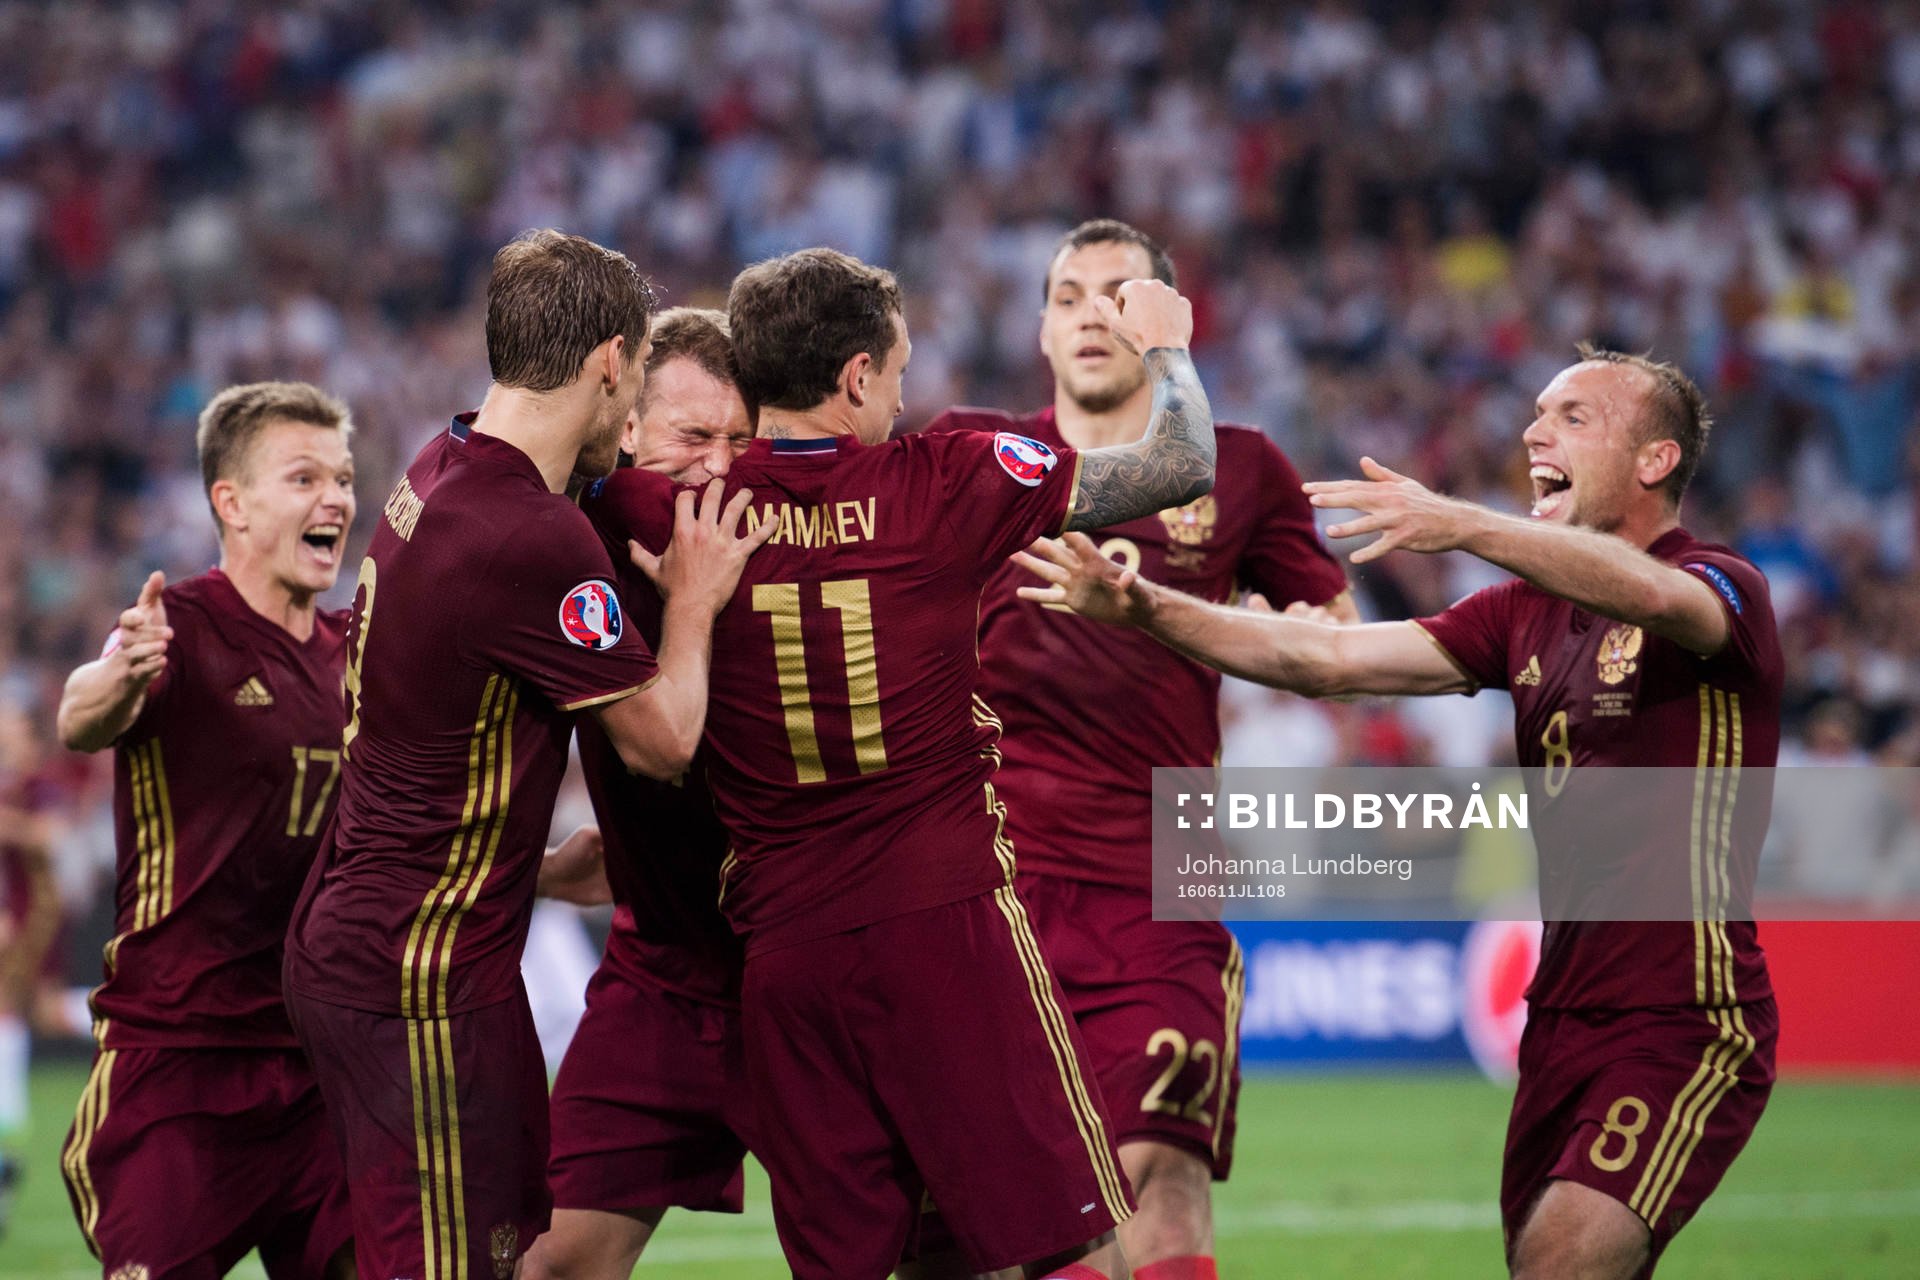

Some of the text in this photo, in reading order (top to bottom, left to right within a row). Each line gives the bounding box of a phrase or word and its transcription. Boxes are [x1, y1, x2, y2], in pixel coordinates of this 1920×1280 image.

[745, 496, 876, 549] MAMAEV
[752, 578, 889, 784] 11
[286, 746, 340, 837] 17
[1541, 710, 1573, 798] 8
[1140, 1028, 1219, 1129] 22
[1589, 1096, 1650, 1173] 8
